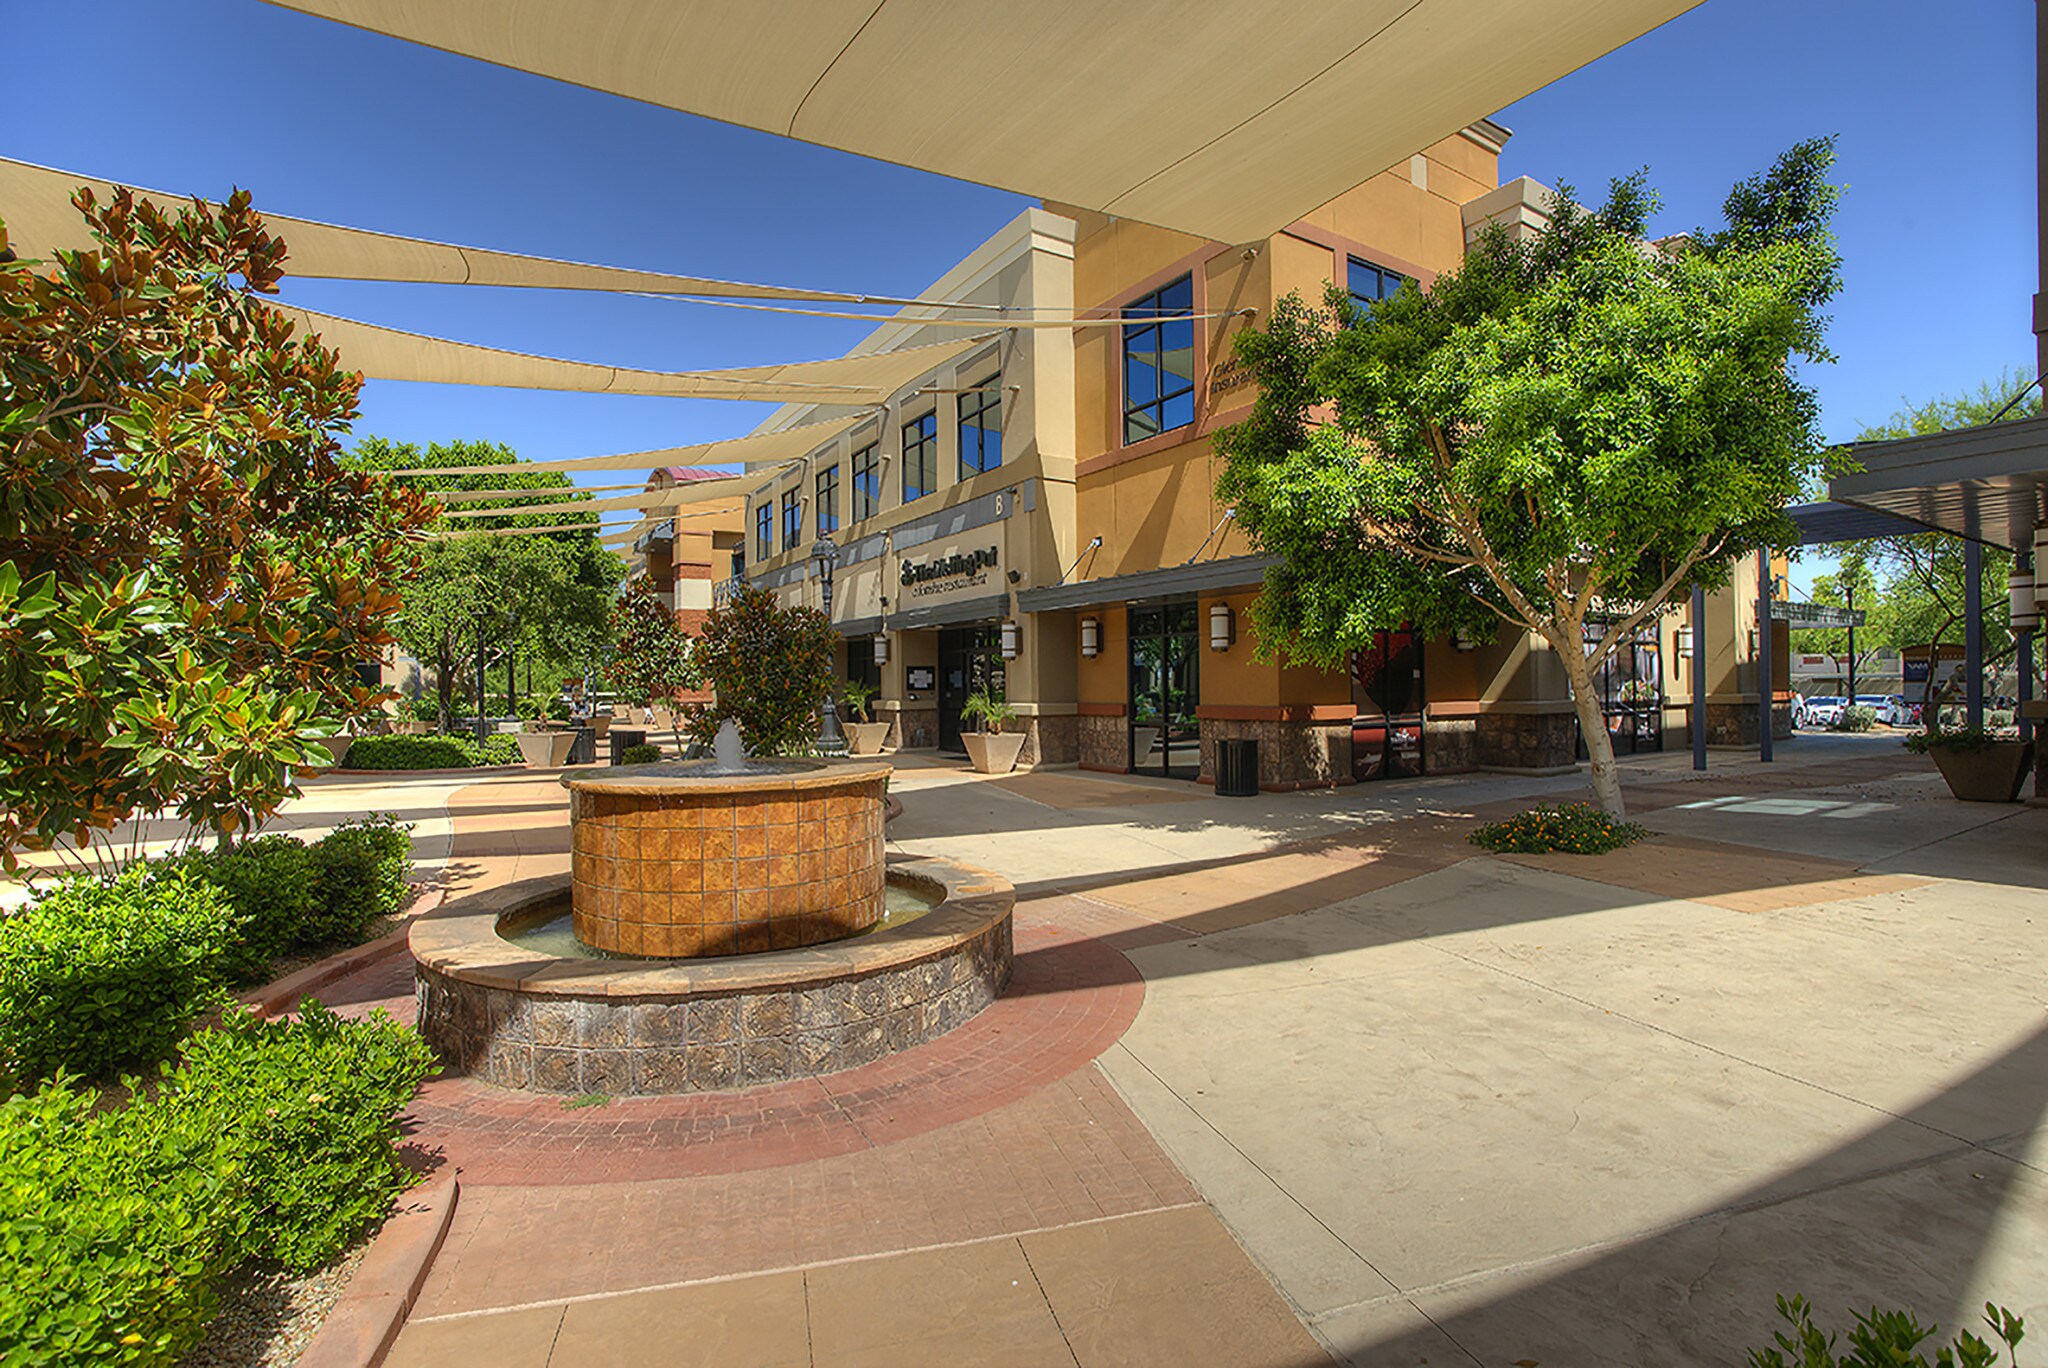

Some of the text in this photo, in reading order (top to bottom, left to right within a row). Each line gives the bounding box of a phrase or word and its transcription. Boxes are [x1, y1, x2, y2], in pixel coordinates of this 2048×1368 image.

[995, 494, 1003, 516] B
[913, 545, 998, 582] The Melting Pot
